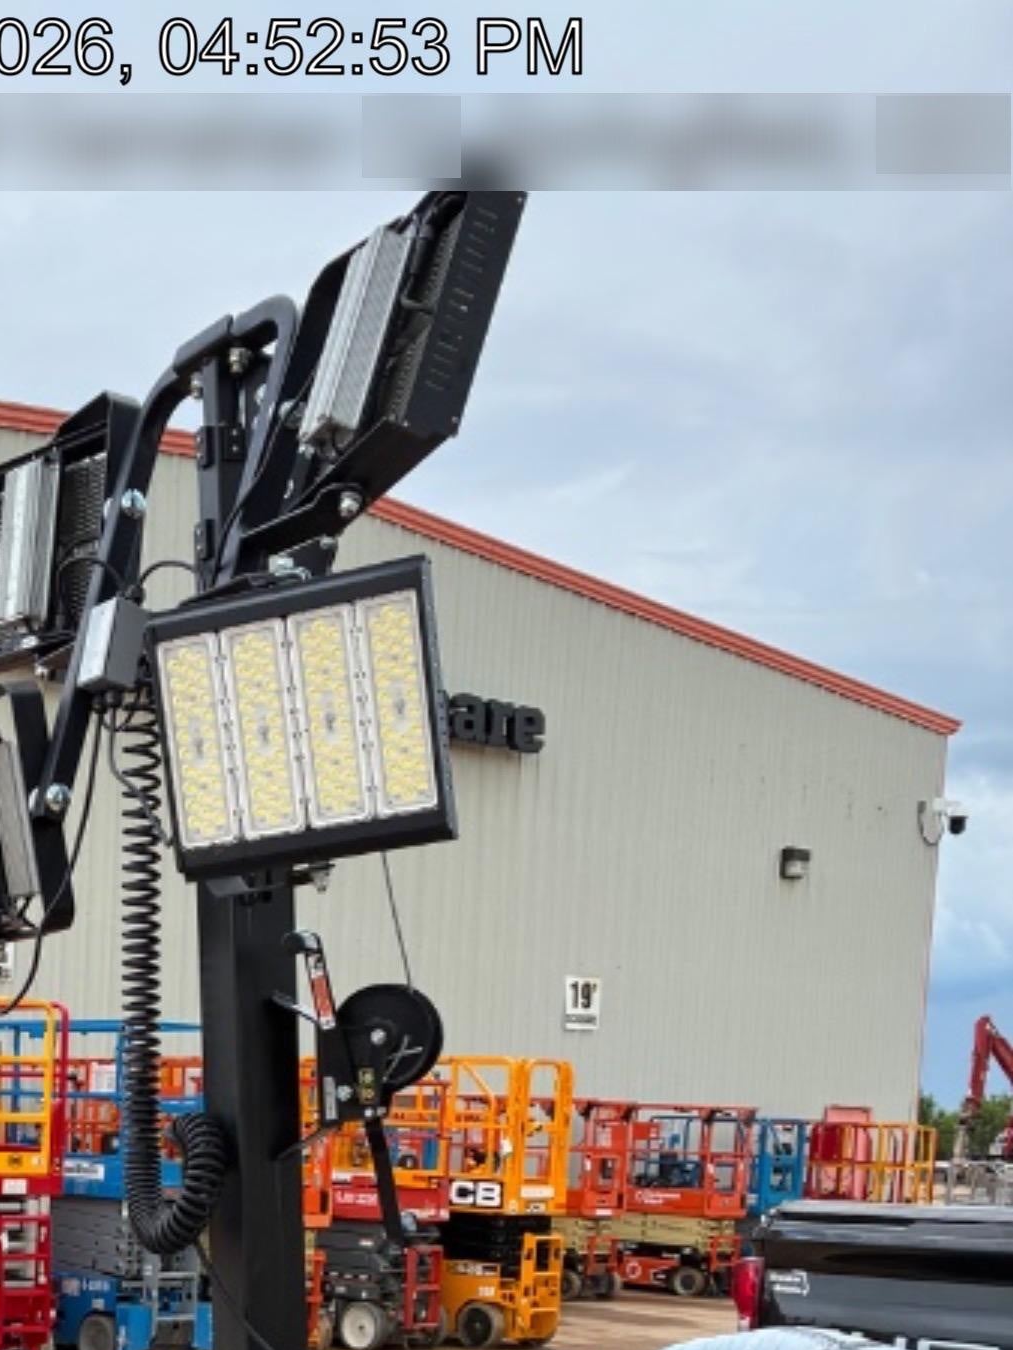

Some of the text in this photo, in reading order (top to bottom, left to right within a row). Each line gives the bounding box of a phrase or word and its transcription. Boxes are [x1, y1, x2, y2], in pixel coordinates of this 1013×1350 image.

[446, 692, 545, 754] are
[571, 981, 597, 1009] 19'
[450, 1180, 502, 1207] CB
